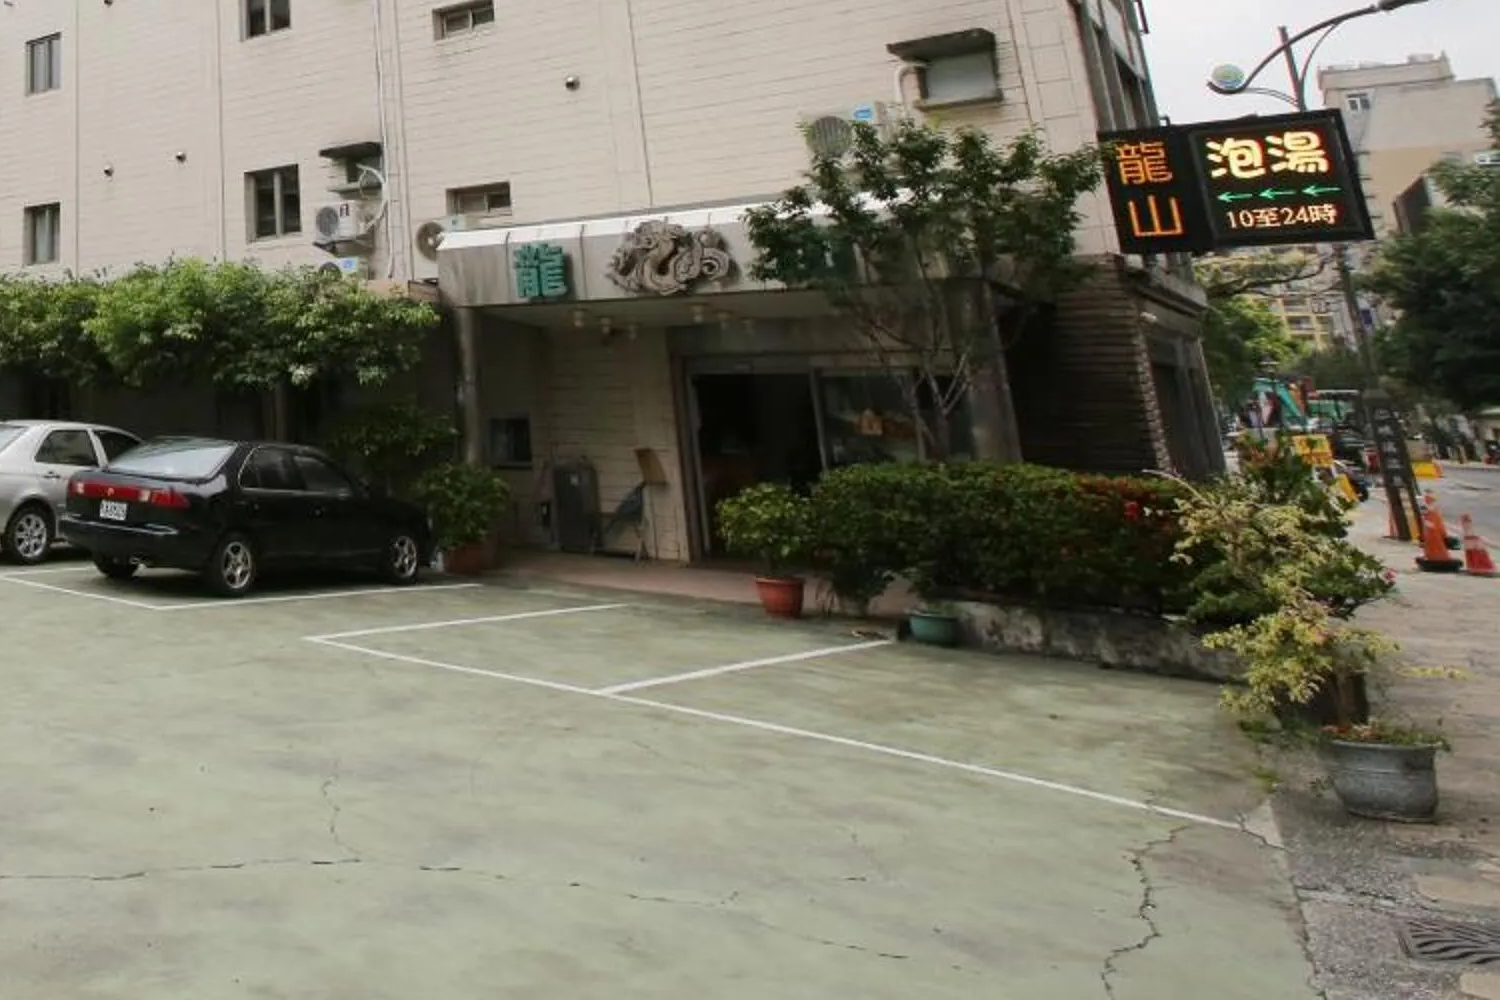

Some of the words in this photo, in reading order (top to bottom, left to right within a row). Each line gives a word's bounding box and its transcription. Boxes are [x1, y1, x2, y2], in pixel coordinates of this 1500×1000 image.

[1205, 130, 1332, 179] 泡湯
[1114, 140, 1185, 238] 龍山
[1225, 203, 1338, 229] 10至24時
[514, 242, 568, 297] 龍
